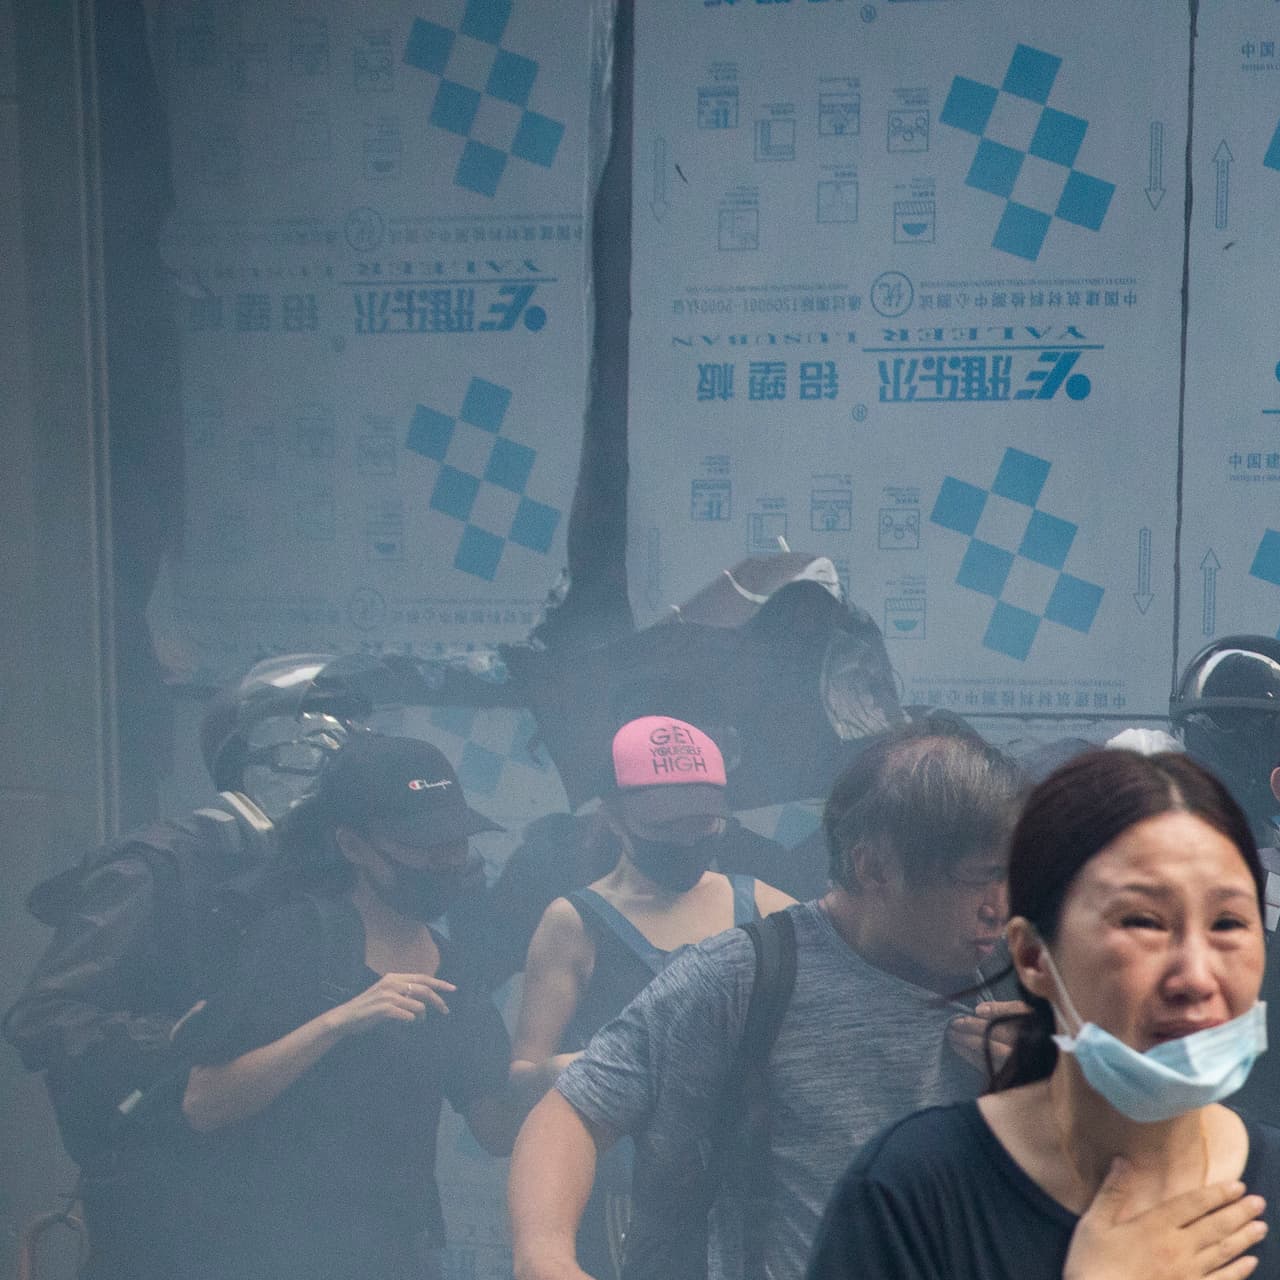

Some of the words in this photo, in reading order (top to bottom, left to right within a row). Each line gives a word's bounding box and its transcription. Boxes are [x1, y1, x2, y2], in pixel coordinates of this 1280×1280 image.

[670, 330, 857, 347] LUSUBAN
[881, 326, 1087, 343] YALEER
[696, 361, 839, 401] 铝塑板
[652, 756, 708, 775] HIGH
